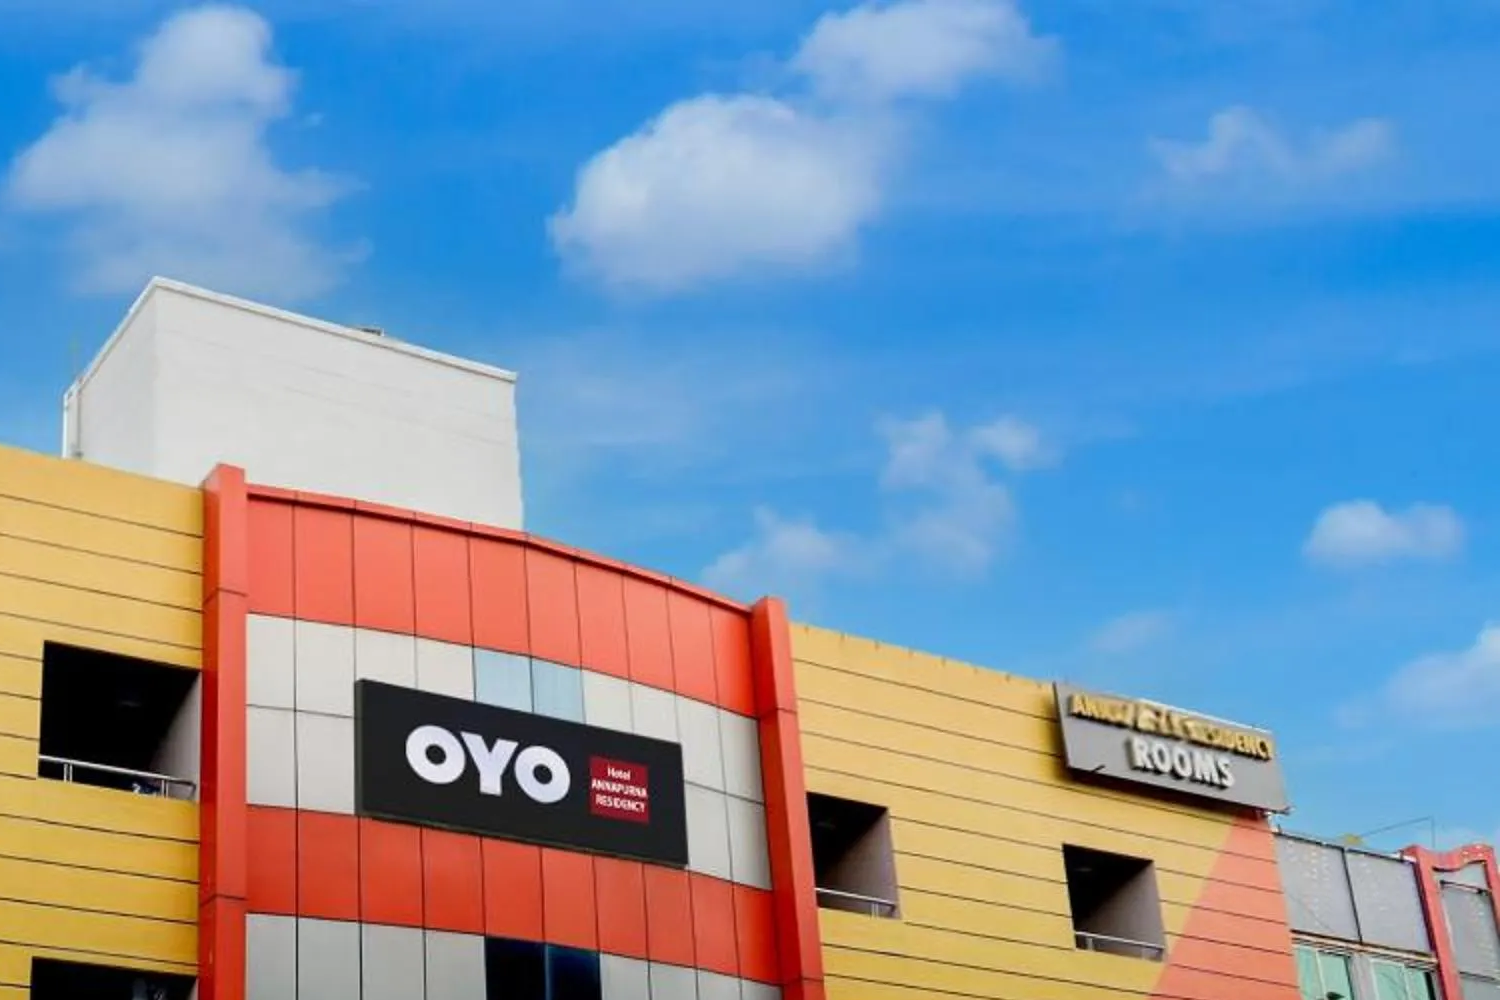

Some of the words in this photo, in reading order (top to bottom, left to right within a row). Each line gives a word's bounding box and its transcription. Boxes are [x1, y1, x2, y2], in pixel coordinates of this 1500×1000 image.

[405, 725, 571, 804] OYO
[1129, 736, 1235, 787] ROOMS
[607, 764, 631, 780] Hotel
[591, 779, 647, 798] ANNAPURNA
[595, 793, 645, 812] RESIDENCY
